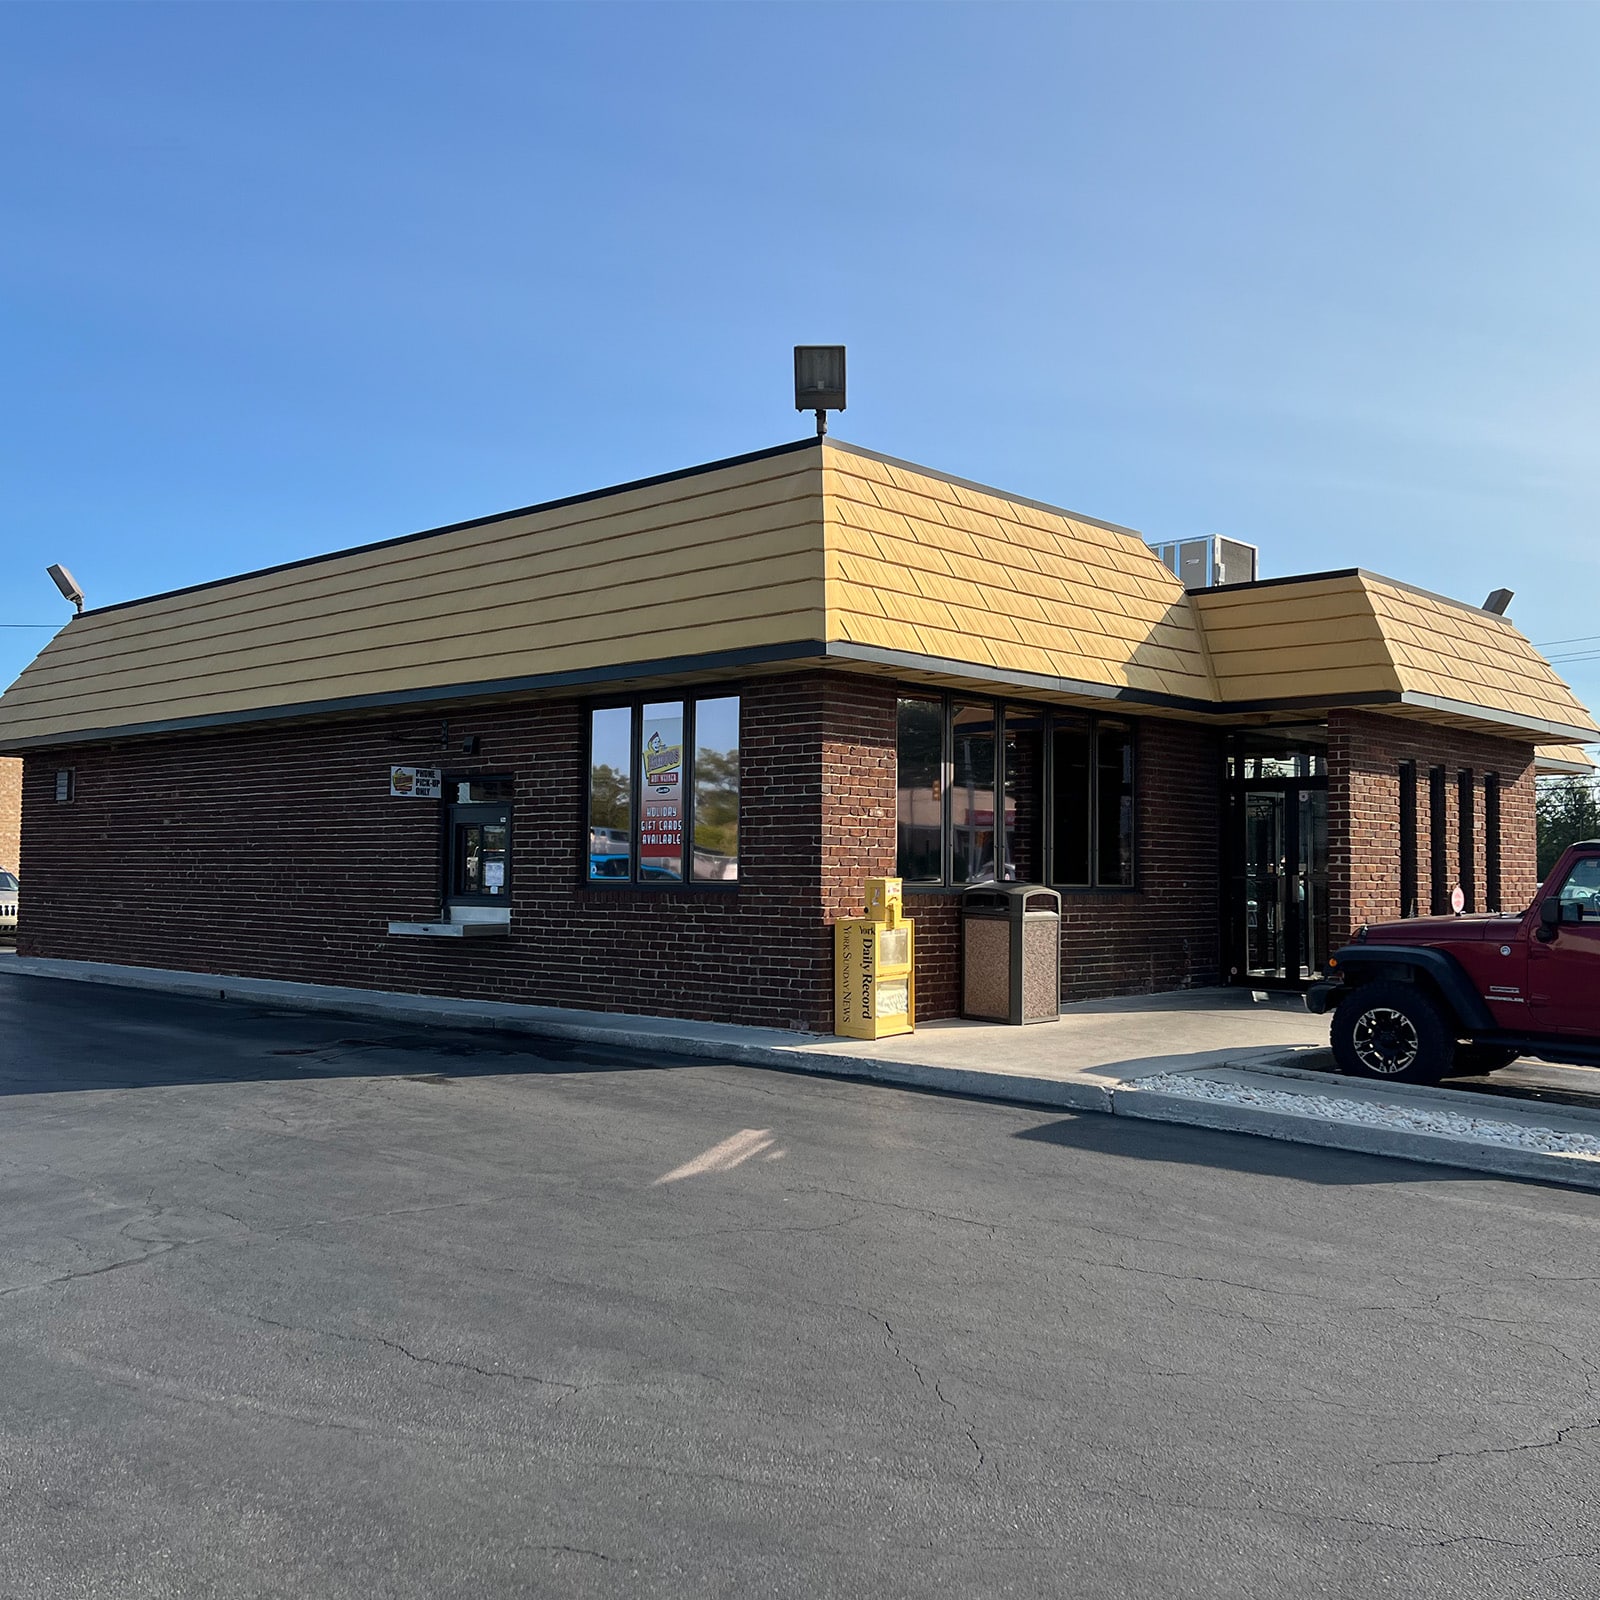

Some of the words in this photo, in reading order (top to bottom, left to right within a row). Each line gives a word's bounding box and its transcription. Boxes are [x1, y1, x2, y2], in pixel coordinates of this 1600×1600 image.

[415, 778, 441, 788] PICK-UP
[415, 787, 431, 796] ONLY
[646, 806, 677, 817] HOLIDAY
[641, 820, 656, 831] GIFT
[658, 819, 682, 831] CARDS
[642, 833, 681, 845] AVAILABLE
[859, 925, 876, 935] York
[859, 938, 873, 972] Daily
[842, 951, 852, 989] SUNDAY
[861, 974, 873, 1020] Record
[842, 991, 852, 1023] NEWS
